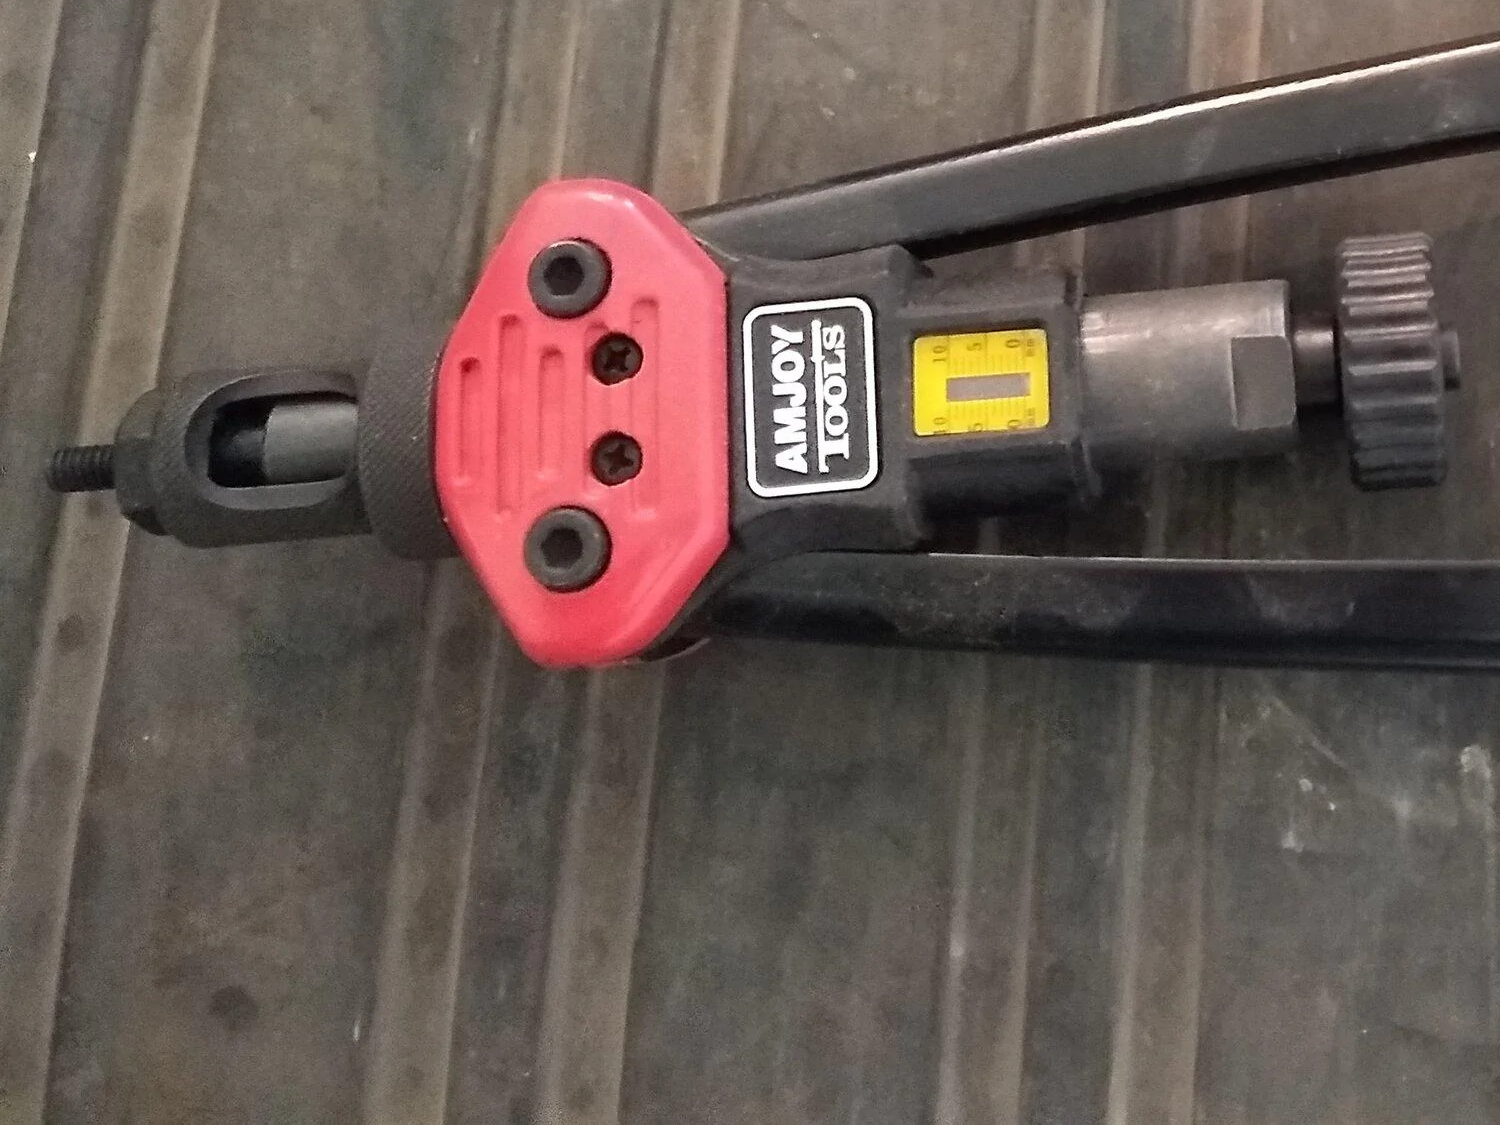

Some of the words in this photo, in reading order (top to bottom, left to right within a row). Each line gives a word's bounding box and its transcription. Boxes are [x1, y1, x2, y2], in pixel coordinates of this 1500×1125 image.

[967, 342, 982, 352] 5
[1005, 338, 1020, 349] 0
[932, 346, 947, 363] 10
[772, 325, 808, 474] AMJOY
[810, 319, 850, 473] TOOLS
